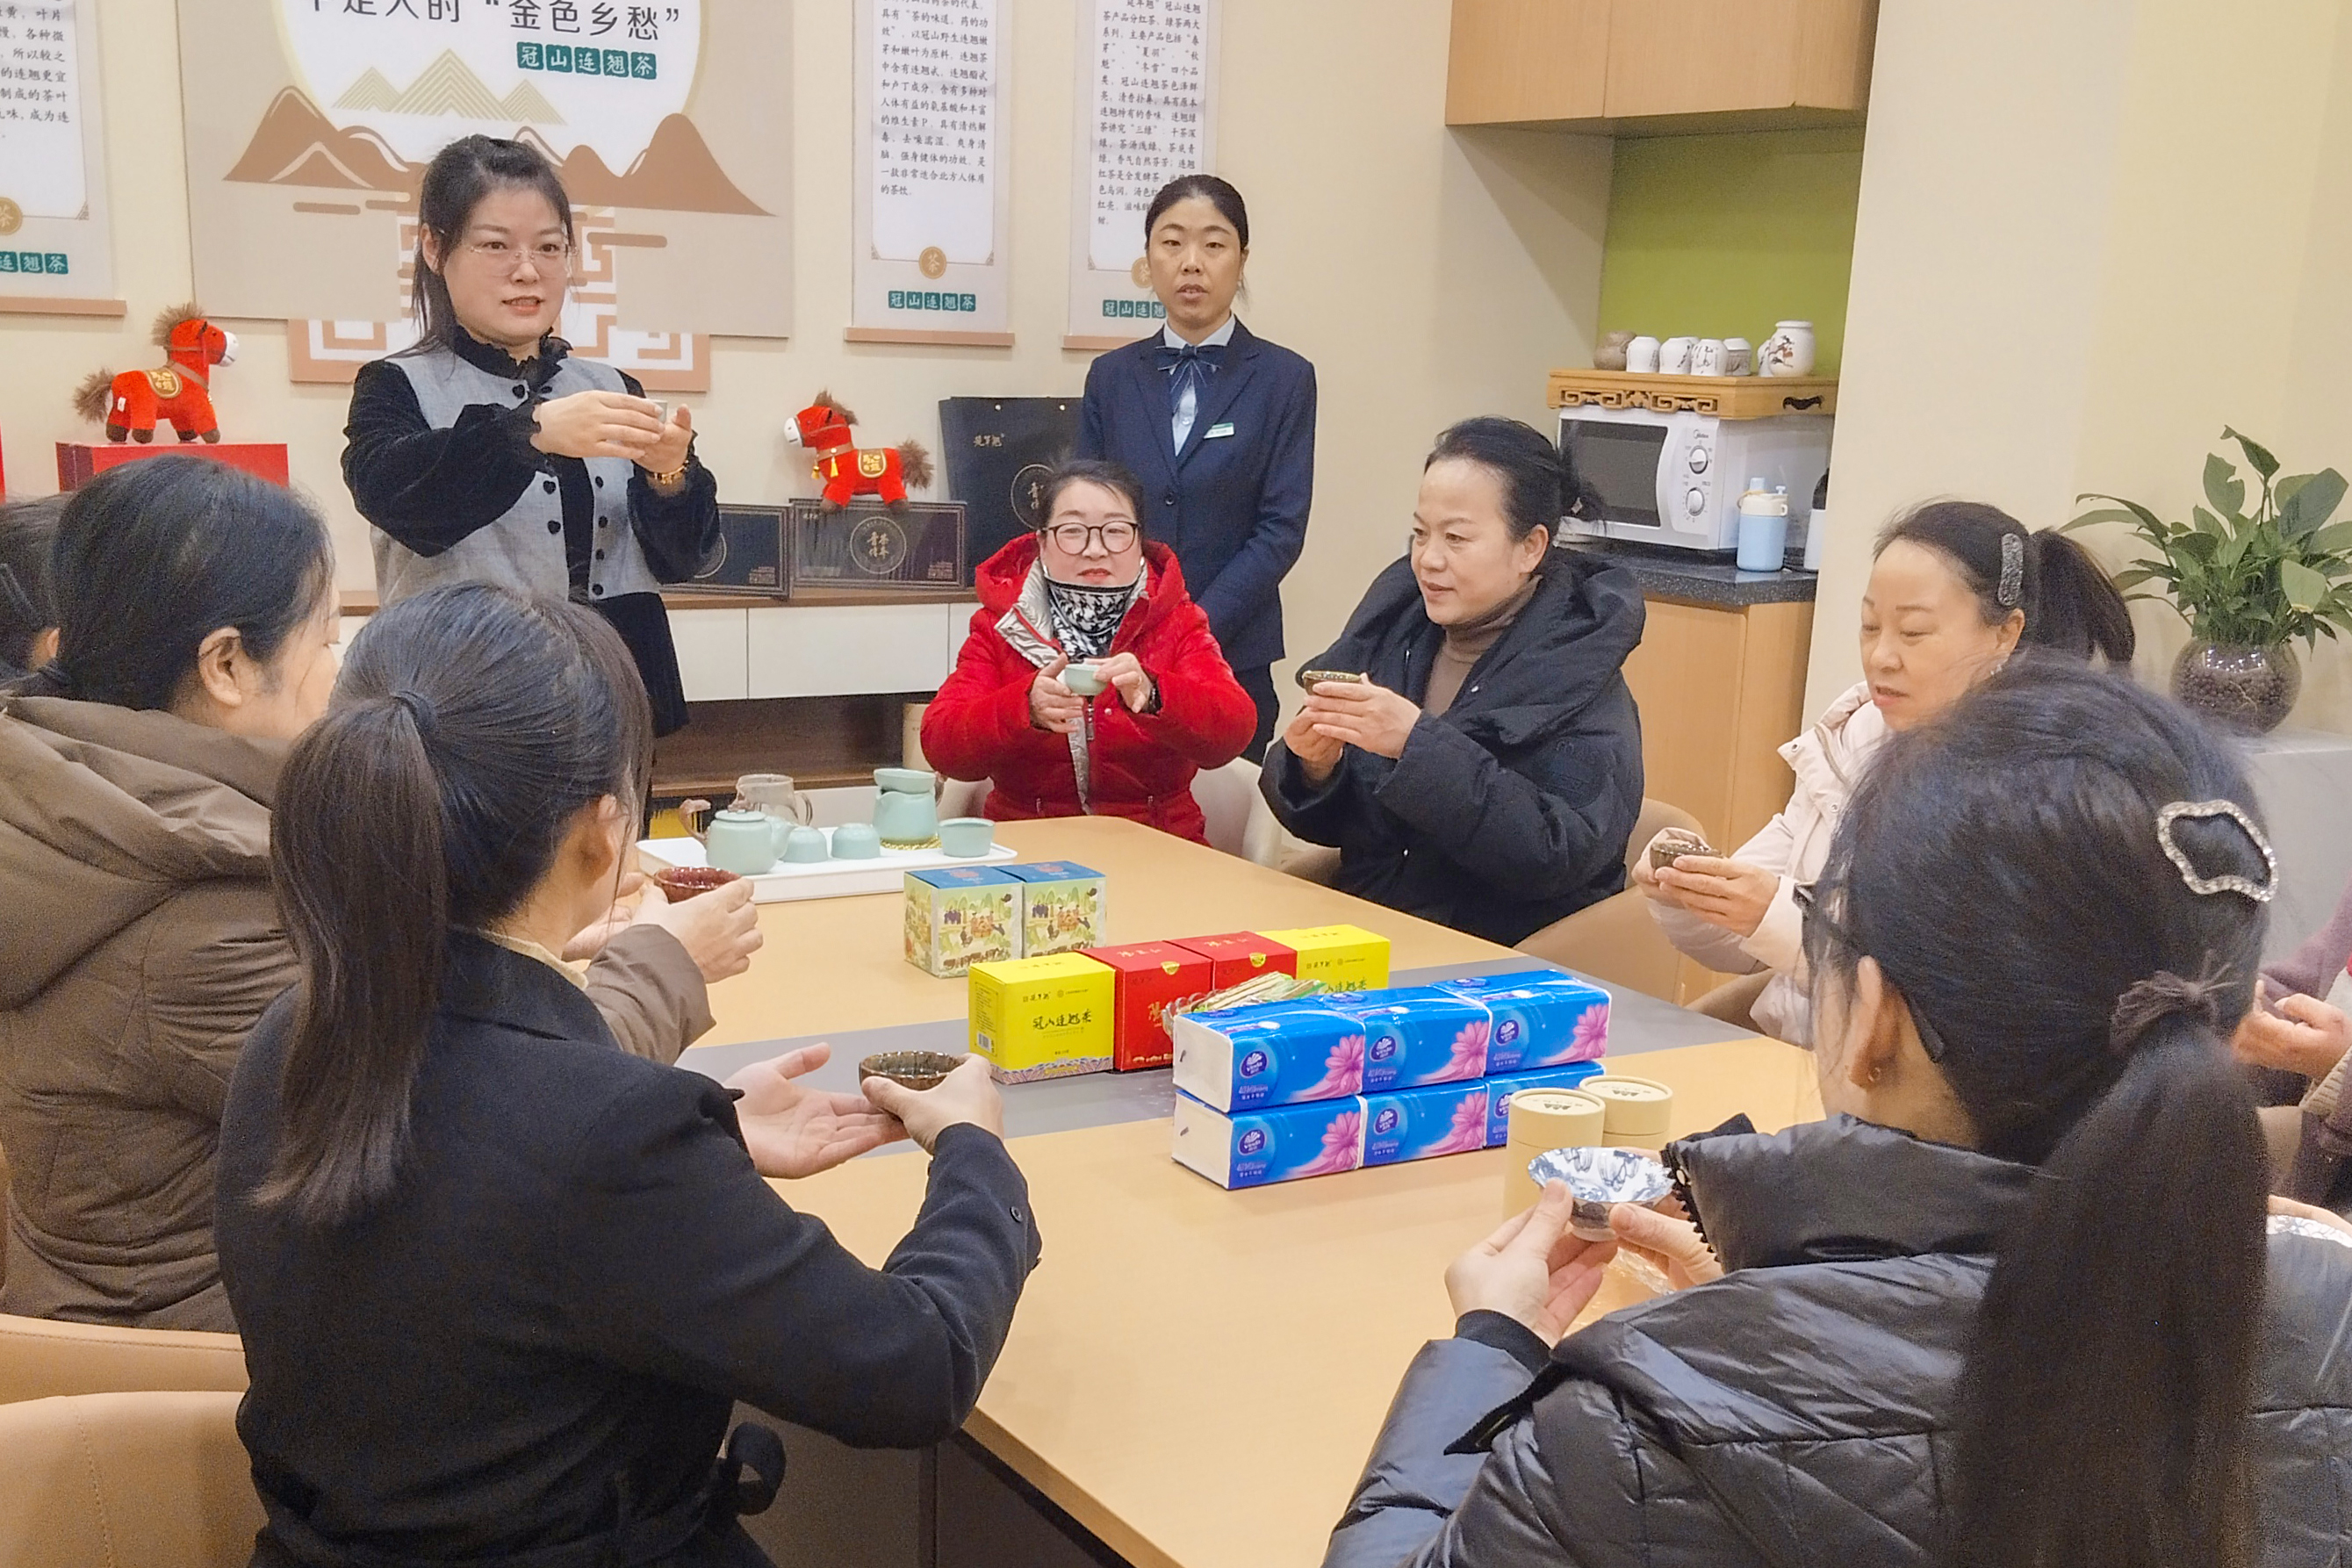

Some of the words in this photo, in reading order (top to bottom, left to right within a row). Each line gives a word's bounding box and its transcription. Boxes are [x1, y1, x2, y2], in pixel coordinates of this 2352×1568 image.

[0, 5, 61, 21] 黄，叶片
[520, 44, 654, 77] 冠山连翘茶
[1, 67, 66, 83] 的连翘更宜
[0, 87, 67, 102] 制成的茶叶
[881, 97, 986, 115] 人体有益的氨基酸和丰富
[881, 168, 984, 183] 一款非常适合北方人体质
[927, 253, 940, 273] 茶
[889, 292, 975, 310] 冠山连翘茶
[1104, 301, 1166, 317] 冠山连翘
